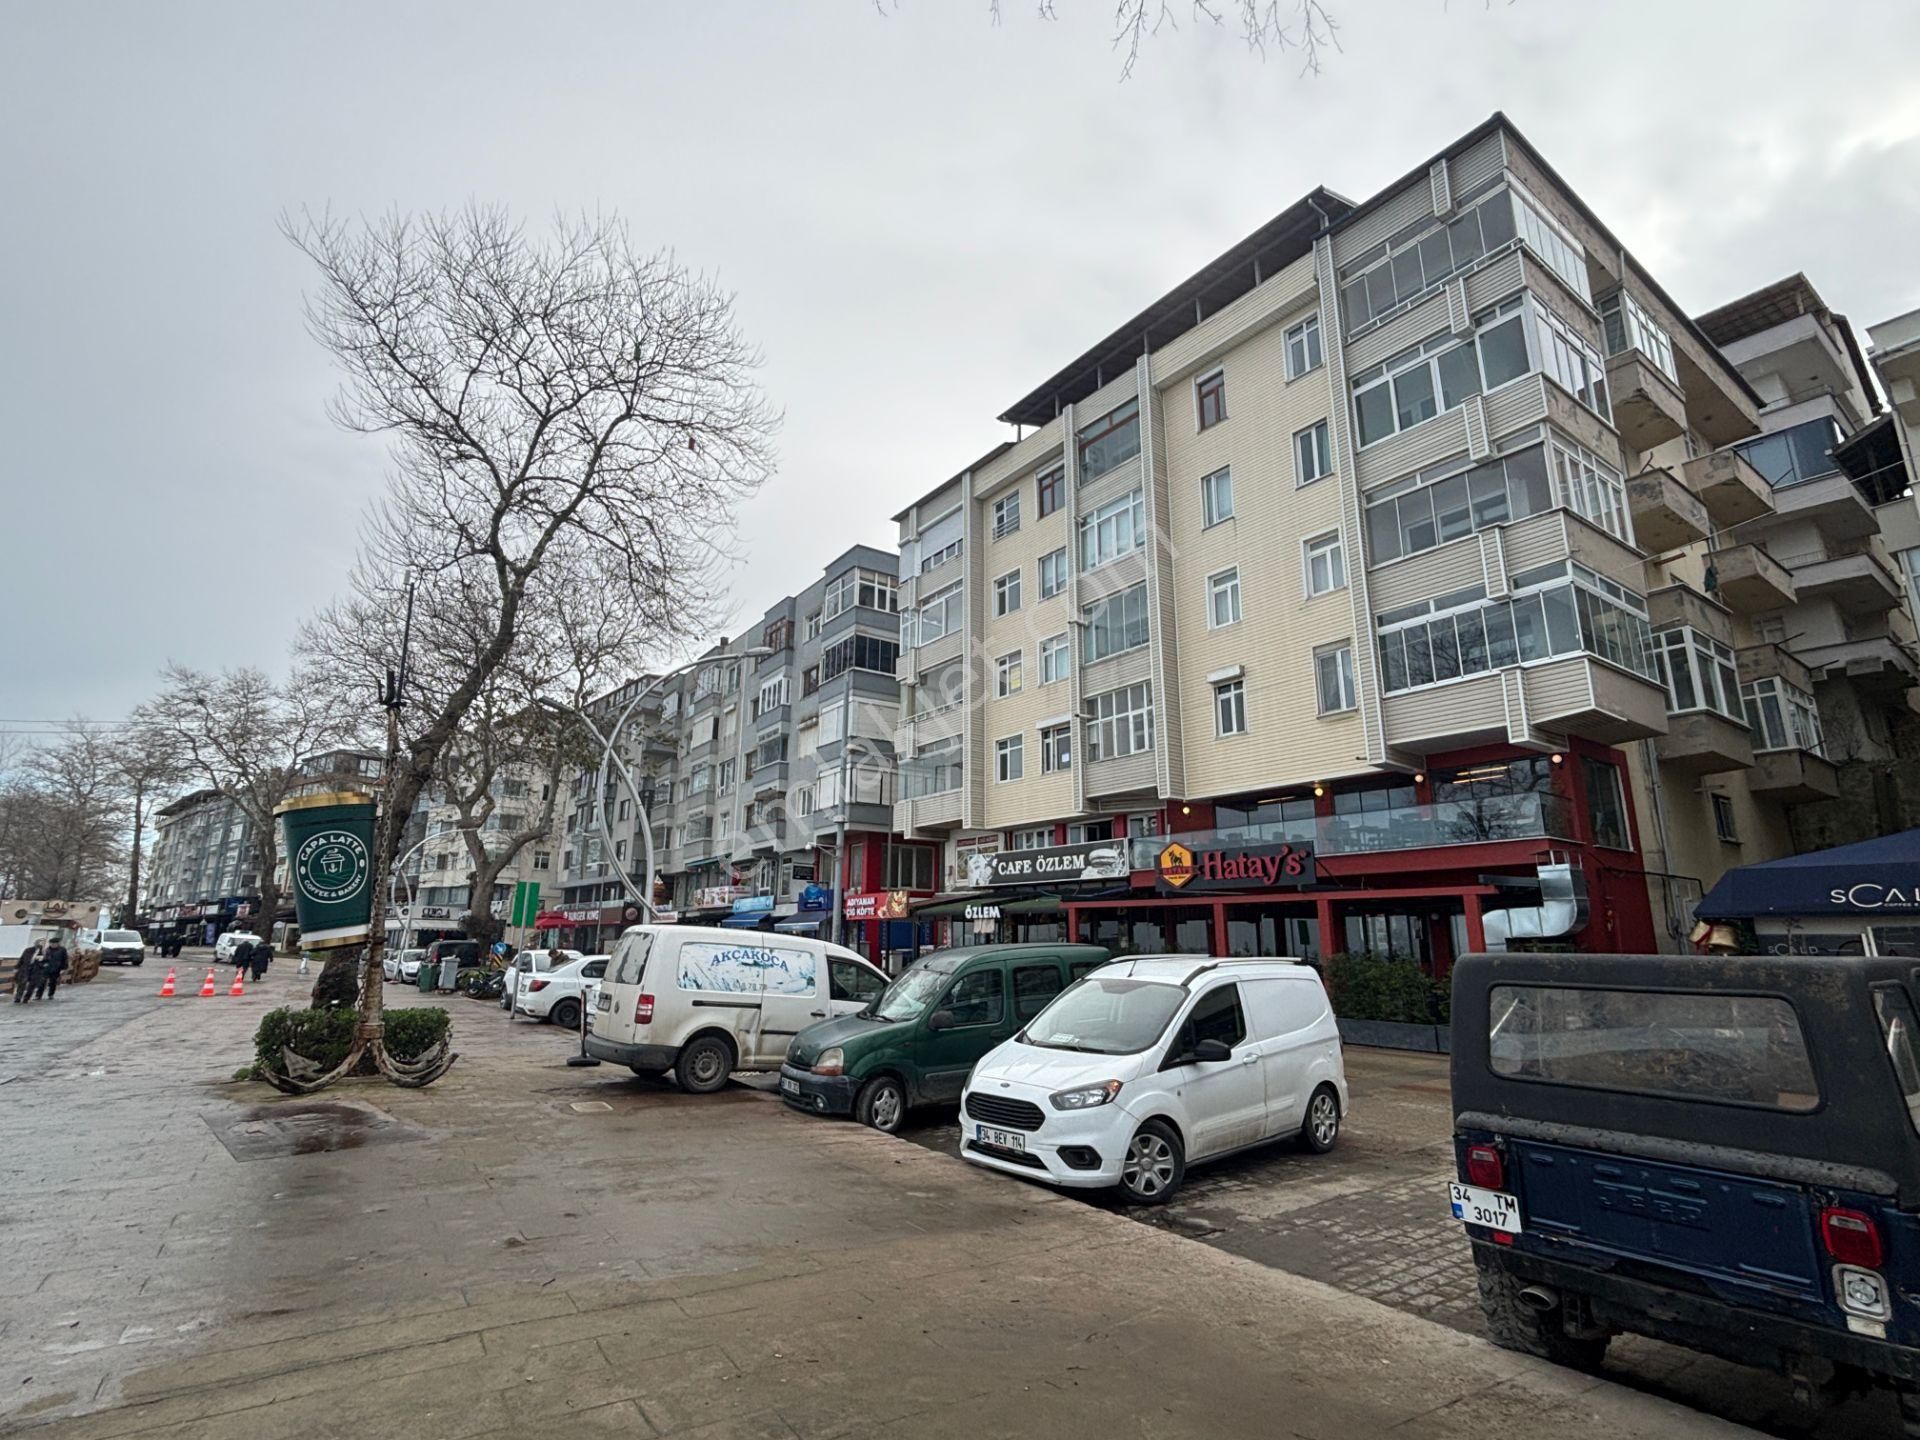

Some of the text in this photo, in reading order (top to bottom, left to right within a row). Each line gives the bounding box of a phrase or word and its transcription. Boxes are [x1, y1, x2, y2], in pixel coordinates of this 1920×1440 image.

[301, 835, 363, 860] CAPA LATTE
[998, 854, 1085, 875] CAFE ÖZLEM
[1203, 844, 1302, 885] Hatay's
[304, 880, 329, 897] COFFEE
[338, 874, 362, 896] BAKERY
[568, 910, 600, 921] BURGER KING
[965, 905, 1000, 919] ÖZLEM
[711, 949, 789, 972] AKÇAKOCA
[981, 1128, 990, 1141] 34
[1011, 1135, 1022, 1149] 114
[1453, 1186, 1516, 1212] 34 TM
[1474, 1206, 1507, 1227] 3017
